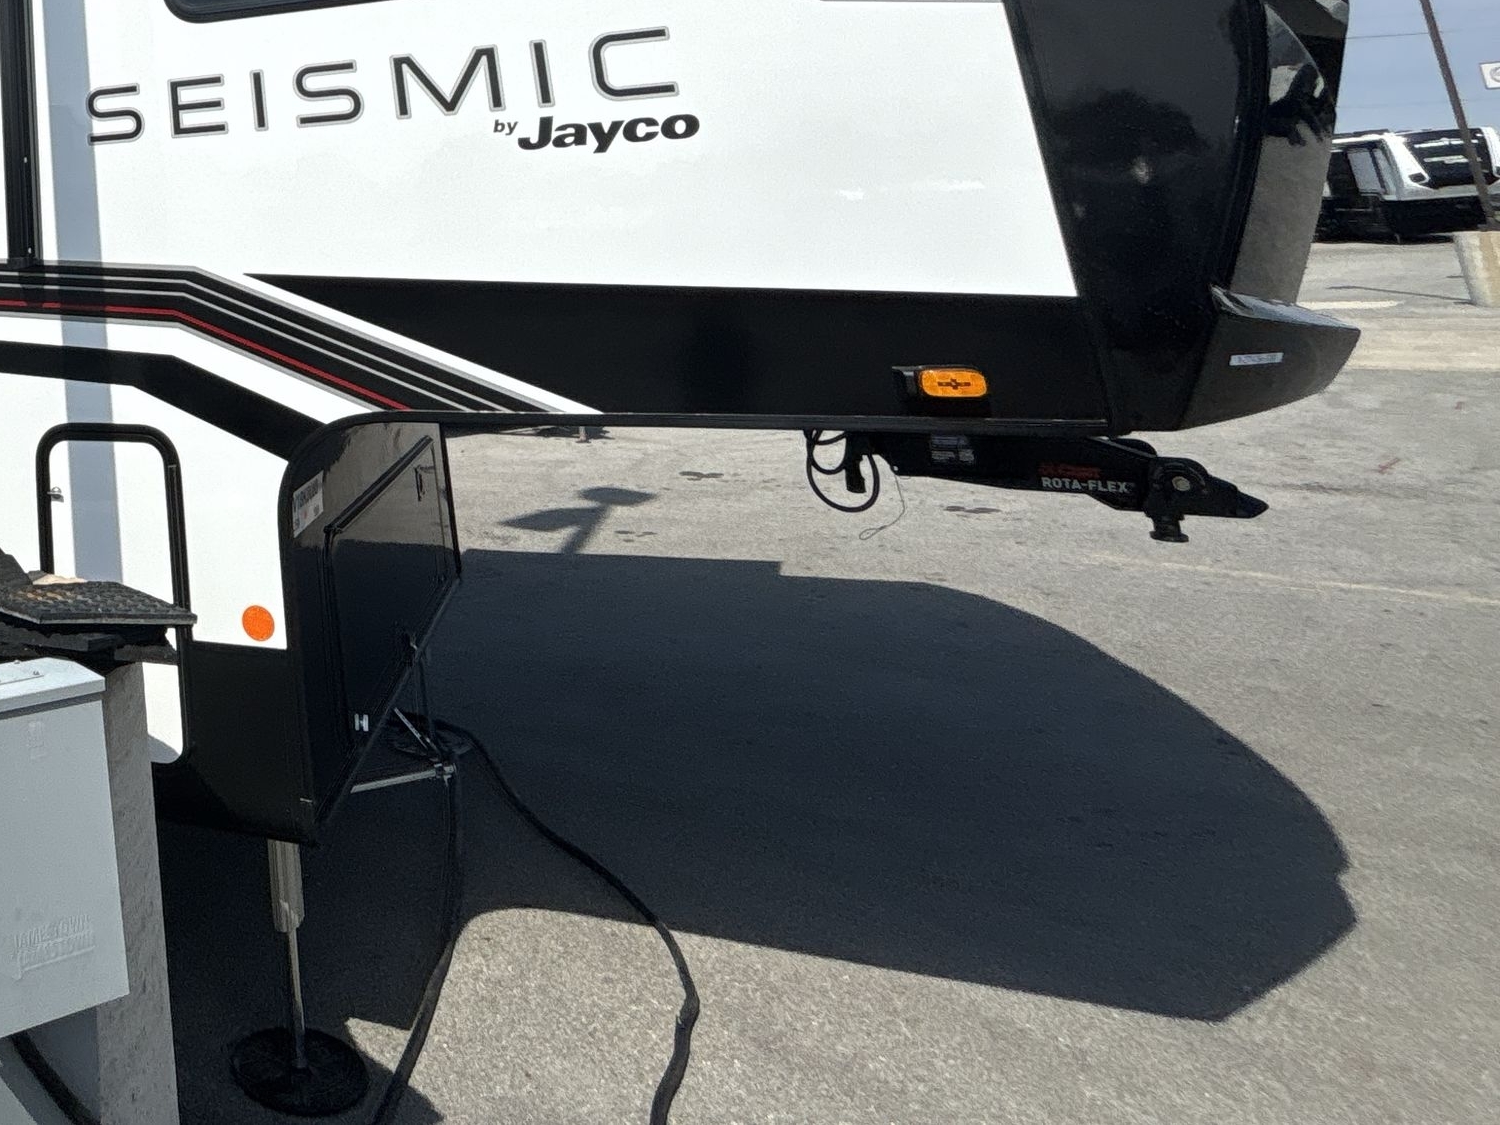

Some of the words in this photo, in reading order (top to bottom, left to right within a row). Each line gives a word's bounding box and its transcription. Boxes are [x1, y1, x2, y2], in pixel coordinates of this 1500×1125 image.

[86, 26, 679, 145] SEISMIC
[493, 119, 518, 135] by
[518, 113, 700, 153] Jayco
[1041, 476, 1130, 493] ROTA-FLEX
